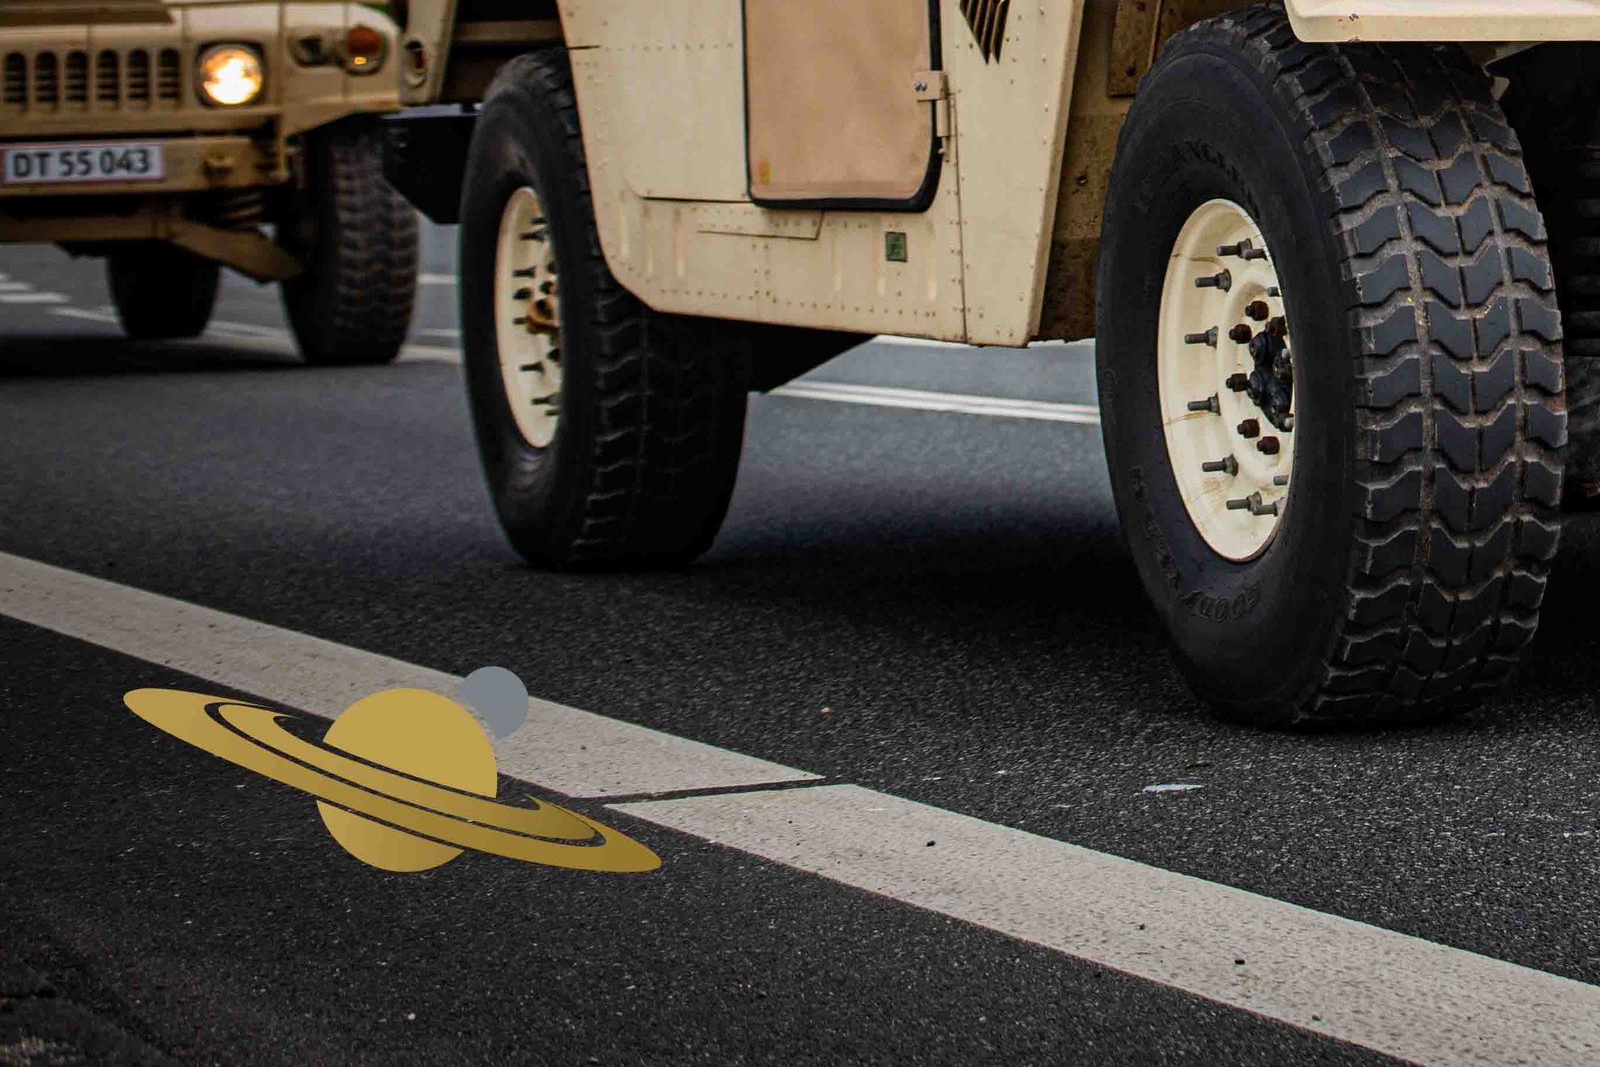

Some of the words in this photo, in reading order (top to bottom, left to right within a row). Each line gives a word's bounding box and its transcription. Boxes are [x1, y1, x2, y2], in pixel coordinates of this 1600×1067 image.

[13, 151, 51, 178] DT
[59, 150, 92, 177] 55
[101, 148, 149, 174] 043
